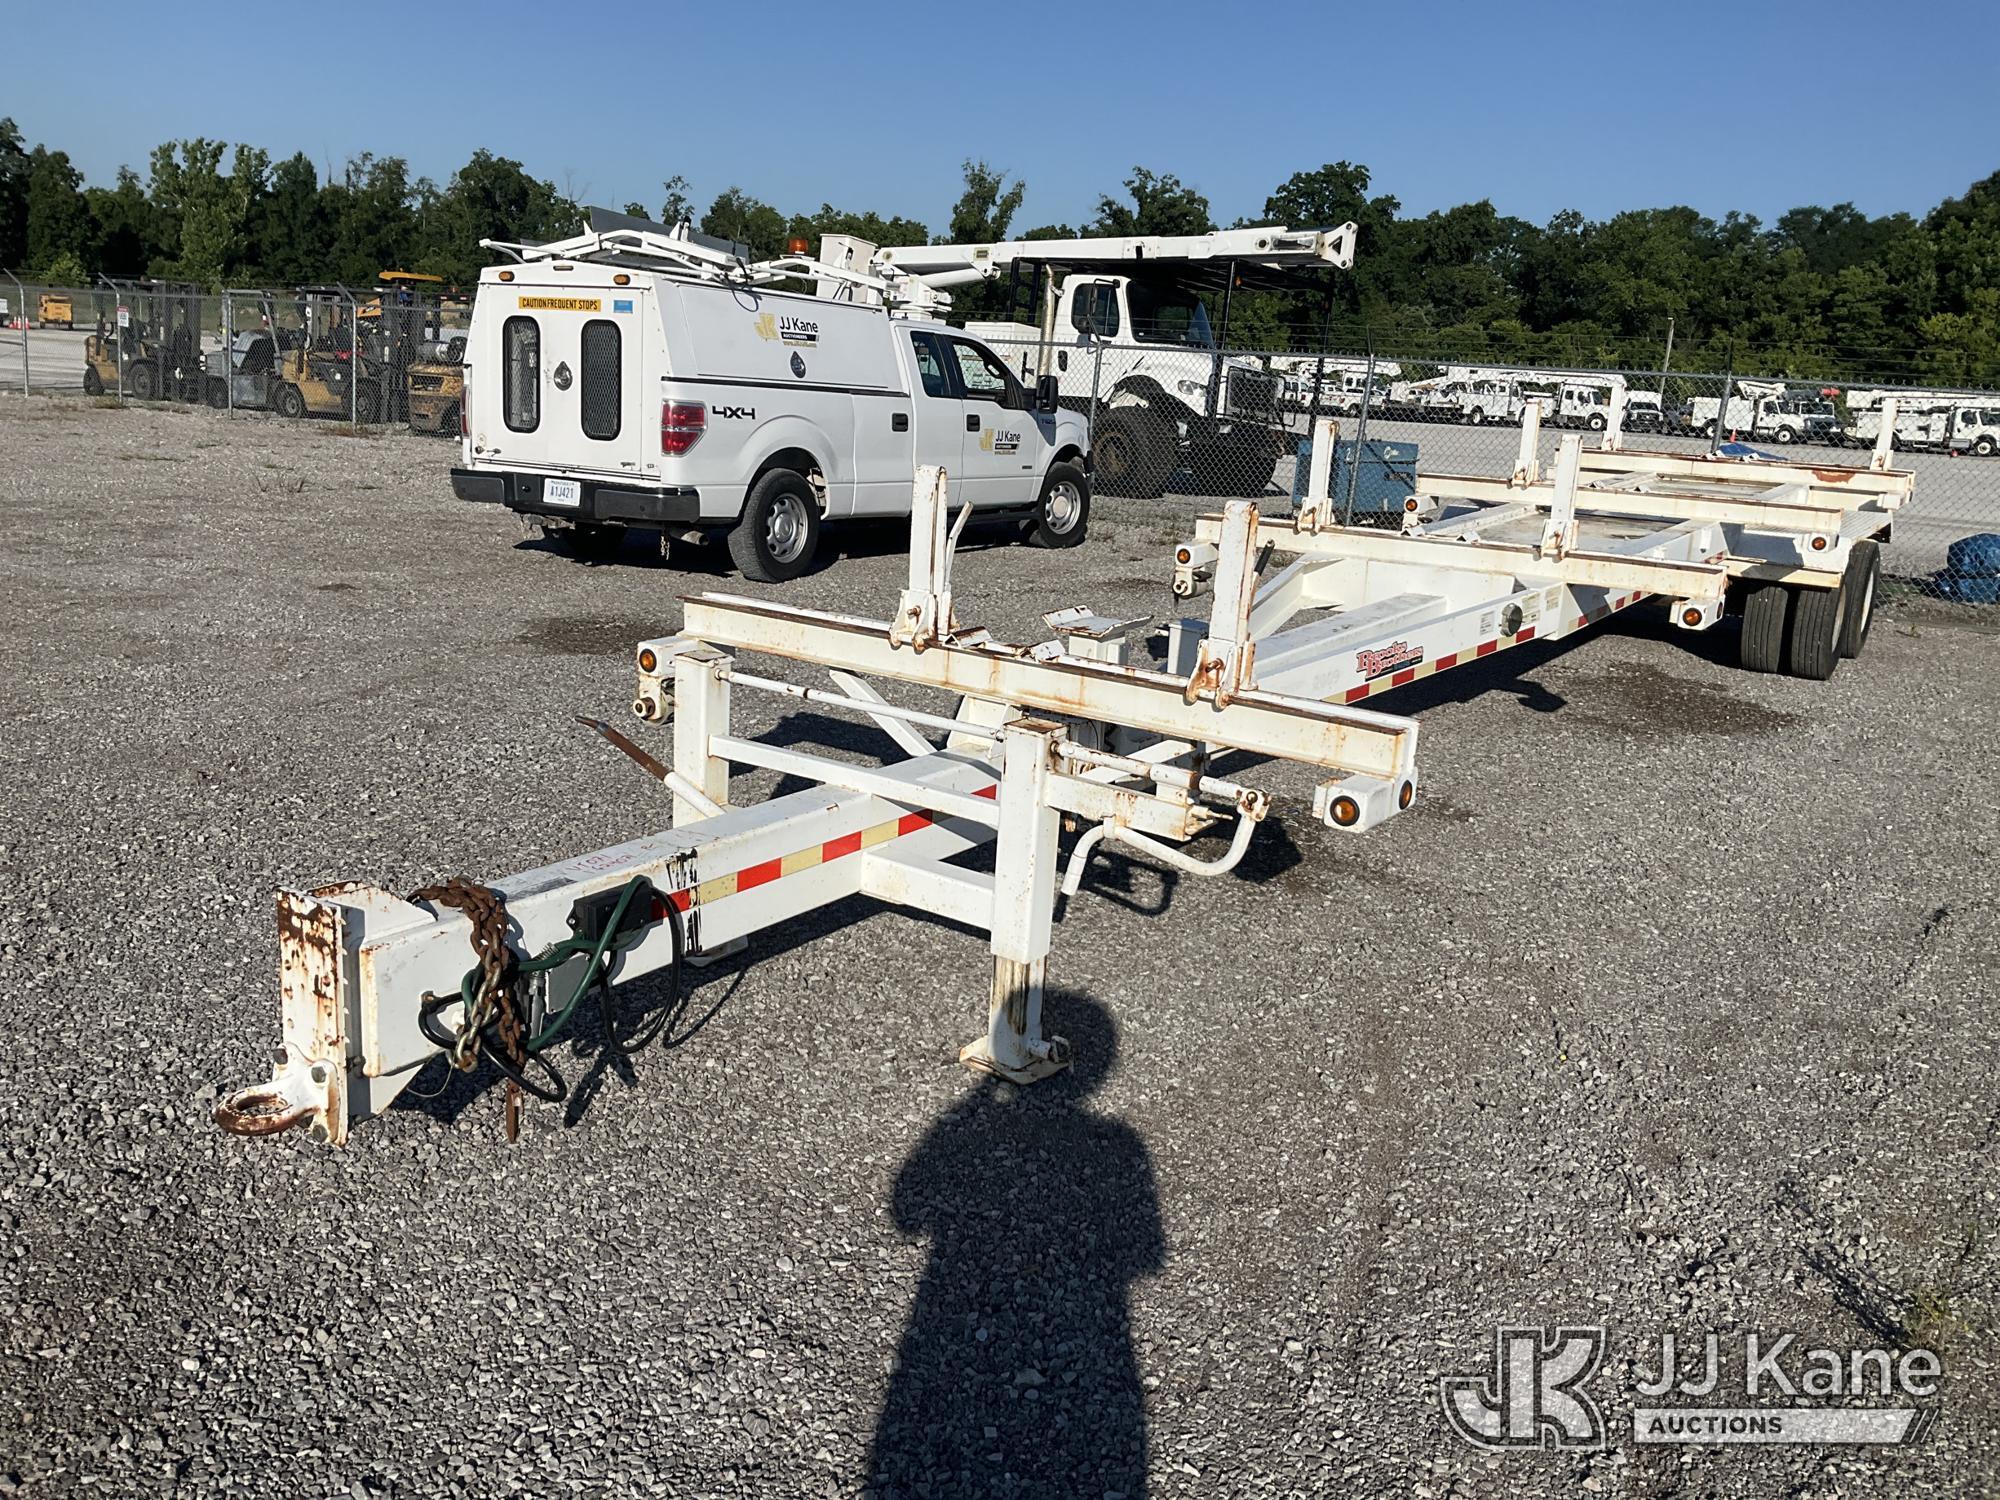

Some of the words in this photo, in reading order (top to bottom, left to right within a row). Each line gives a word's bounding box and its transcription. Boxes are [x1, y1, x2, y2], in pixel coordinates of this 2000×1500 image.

[522, 298, 547, 308] CAUTION
[547, 299, 577, 309] FREQUENT
[578, 300, 598, 310] STOPS
[780, 316, 790, 330] JJ
[792, 317, 818, 332] Kane
[996, 430, 1004, 442] JJ
[1004, 430, 1021, 442] Kane
[1356, 641, 1407, 673] Brooks
[1365, 645, 1423, 679] Brothers
